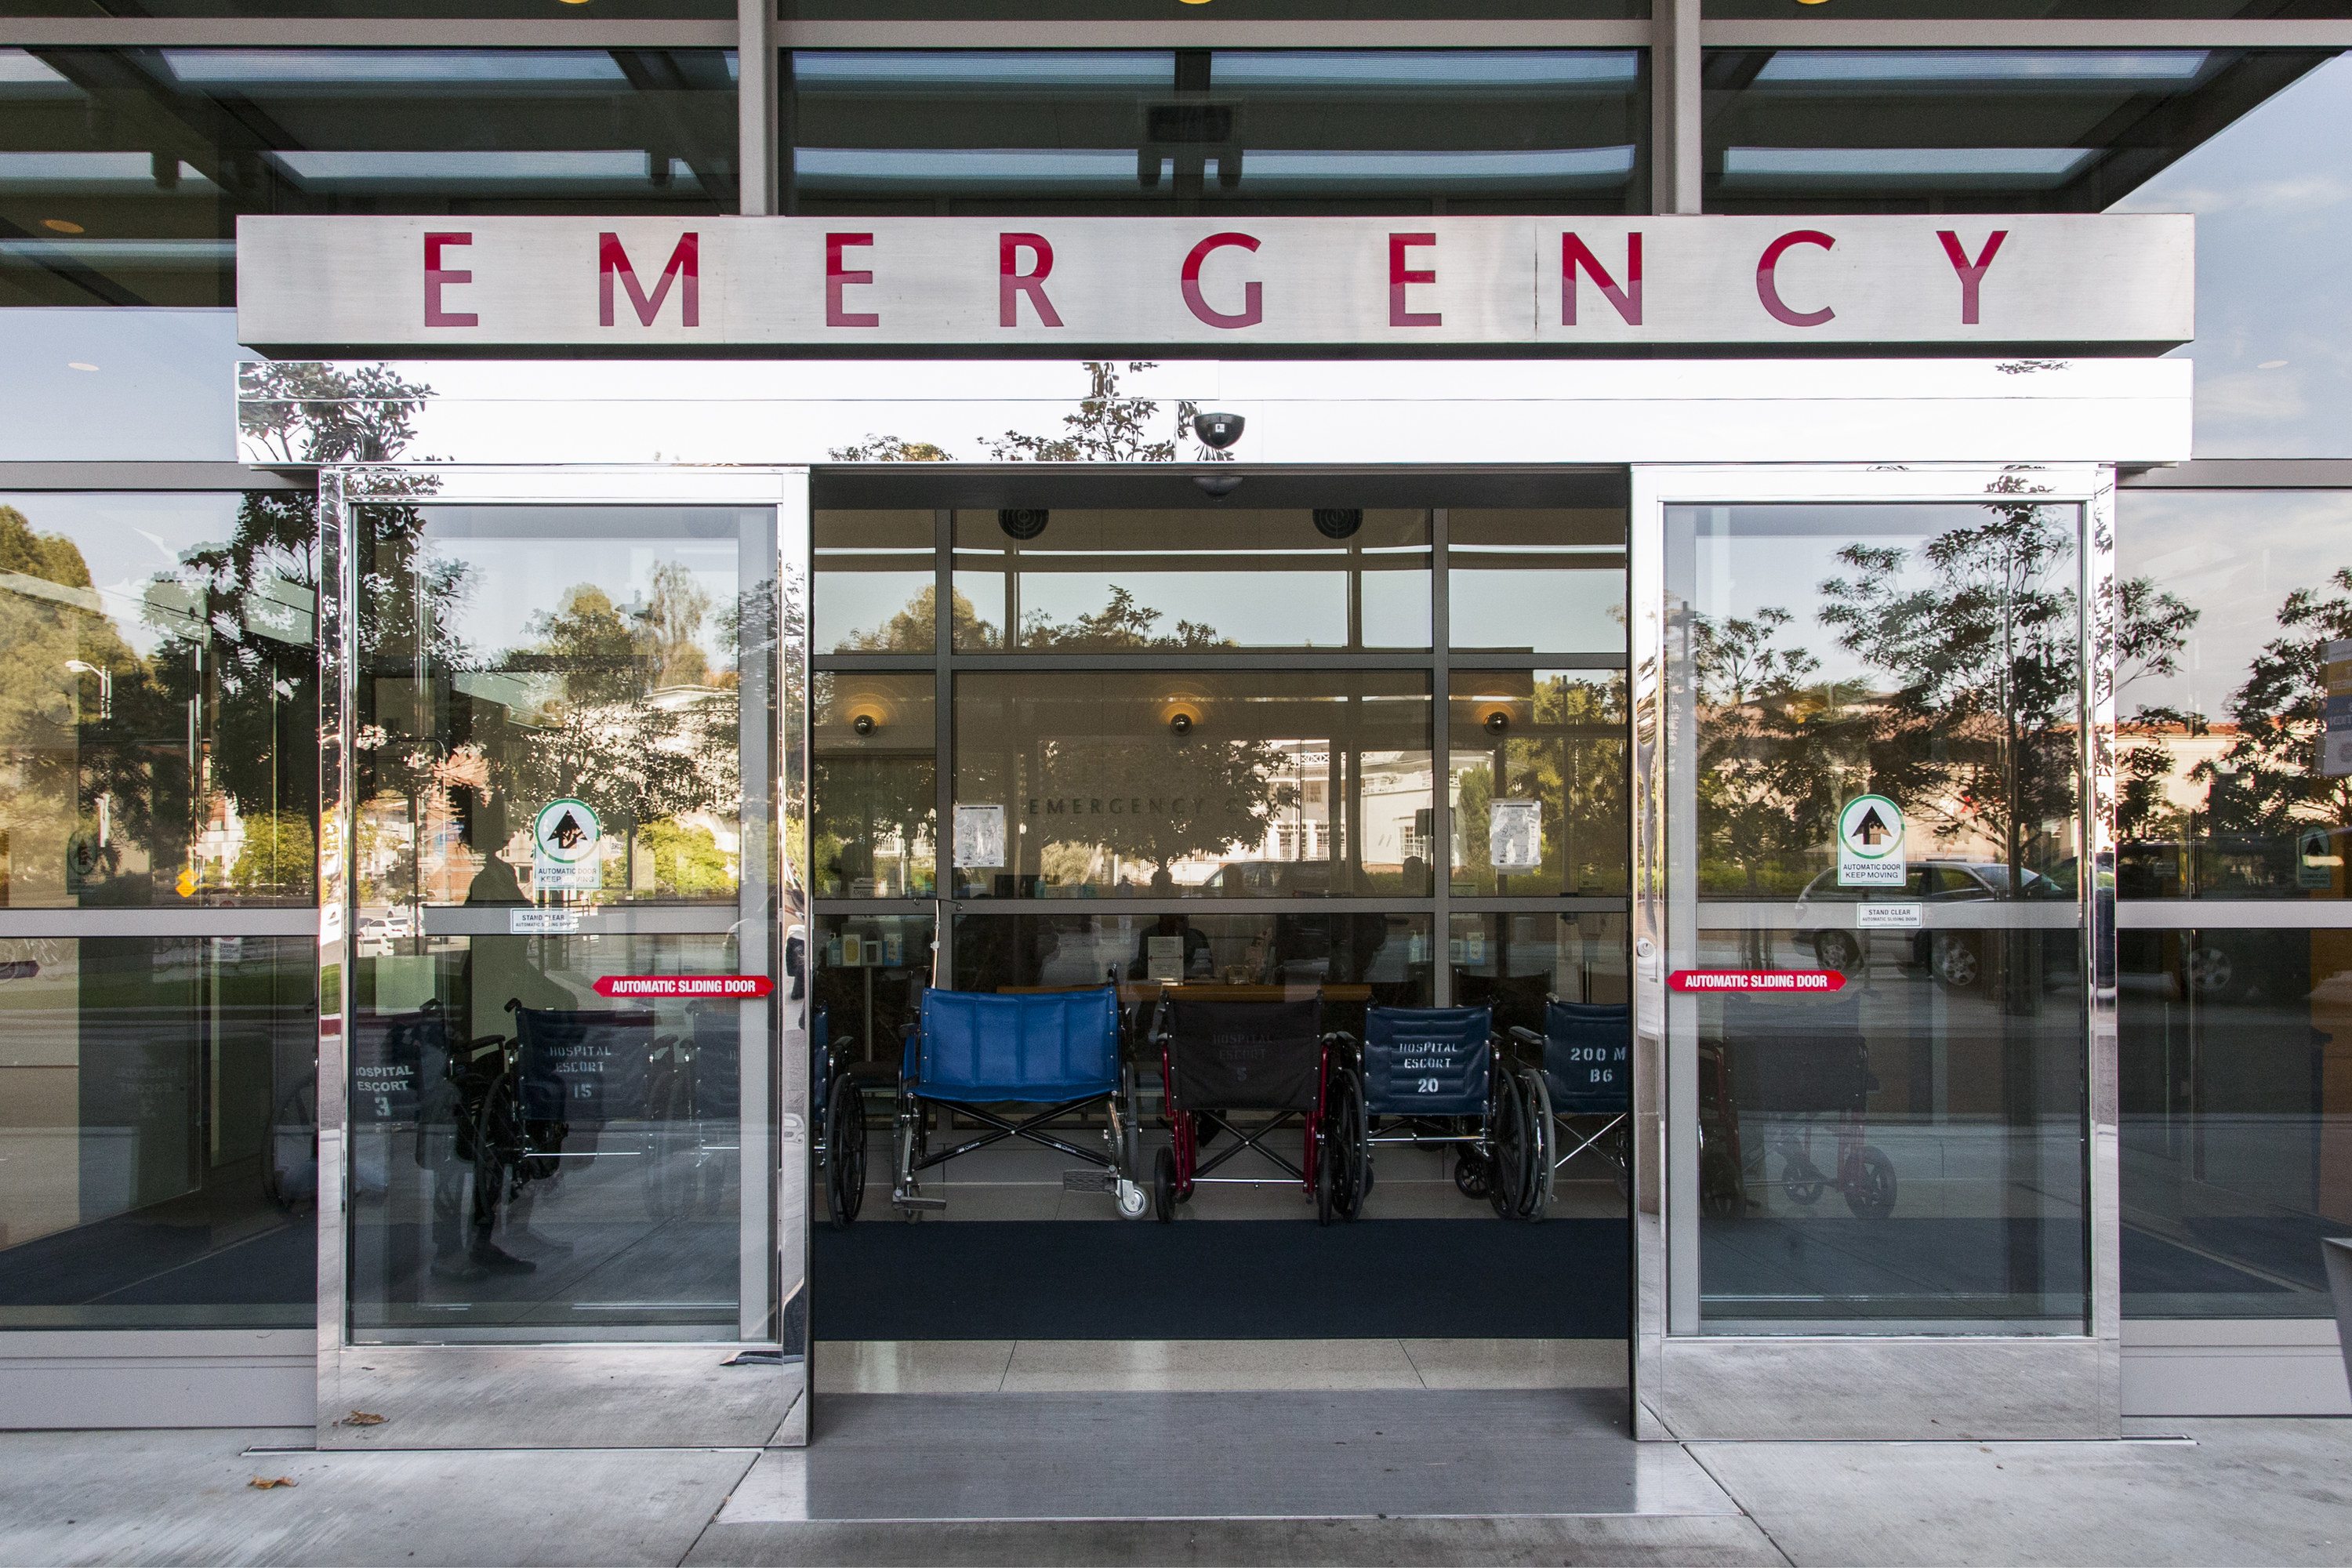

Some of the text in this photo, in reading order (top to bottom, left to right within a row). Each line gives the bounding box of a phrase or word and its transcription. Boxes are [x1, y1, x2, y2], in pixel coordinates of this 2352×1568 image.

[424, 230, 2006, 328] EMERGENCY
[1029, 798, 1203, 815] EMERGENCY
[612, 980, 756, 993] AUTOMATIC SLIDING DOOR
[1685, 975, 1828, 988] AUTOMATIC SLIDING DOOR
[1212, 1033, 1273, 1045] HOSPITAL
[550, 1045, 612, 1057] HOSPITAL
[1399, 1041, 1458, 1053] HOSPITAL
[1219, 1048, 1266, 1060] ESCORT
[1570, 1047, 1606, 1062] 200
[555, 1061, 604, 1073] ESCORT
[1404, 1058, 1451, 1069] ESCORT
[1236, 1066, 1247, 1081] 5
[357, 1080, 408, 1092] ESCORT
[574, 1083, 593, 1098] 15
[1417, 1078, 1439, 1093] 20
[374, 1096, 391, 1116] 3
